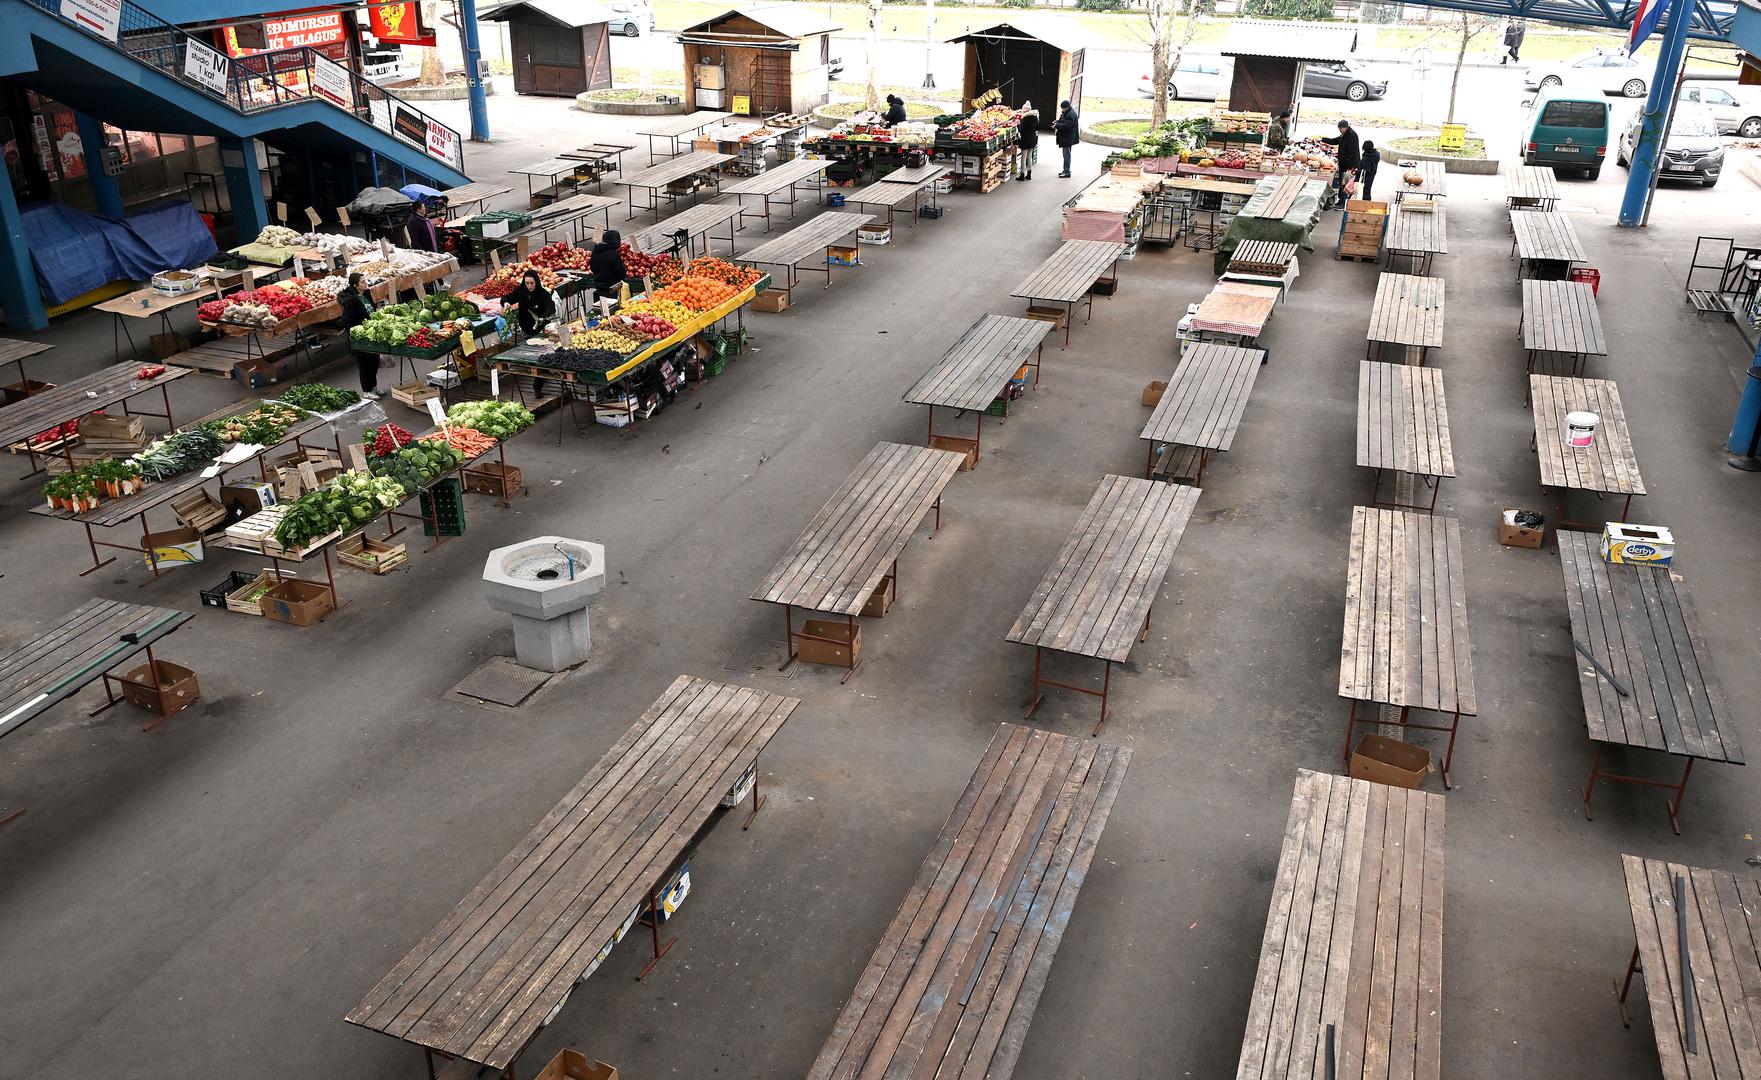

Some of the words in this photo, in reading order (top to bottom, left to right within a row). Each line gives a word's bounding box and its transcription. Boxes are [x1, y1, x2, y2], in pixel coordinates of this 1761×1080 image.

[190, 41, 213, 58] frizerski
[191, 52, 210, 66] studio
[204, 67, 215, 80] kat
[427, 120, 453, 143] ARMUS
[431, 134, 446, 149] GYM
[1628, 545, 1655, 556] derby
